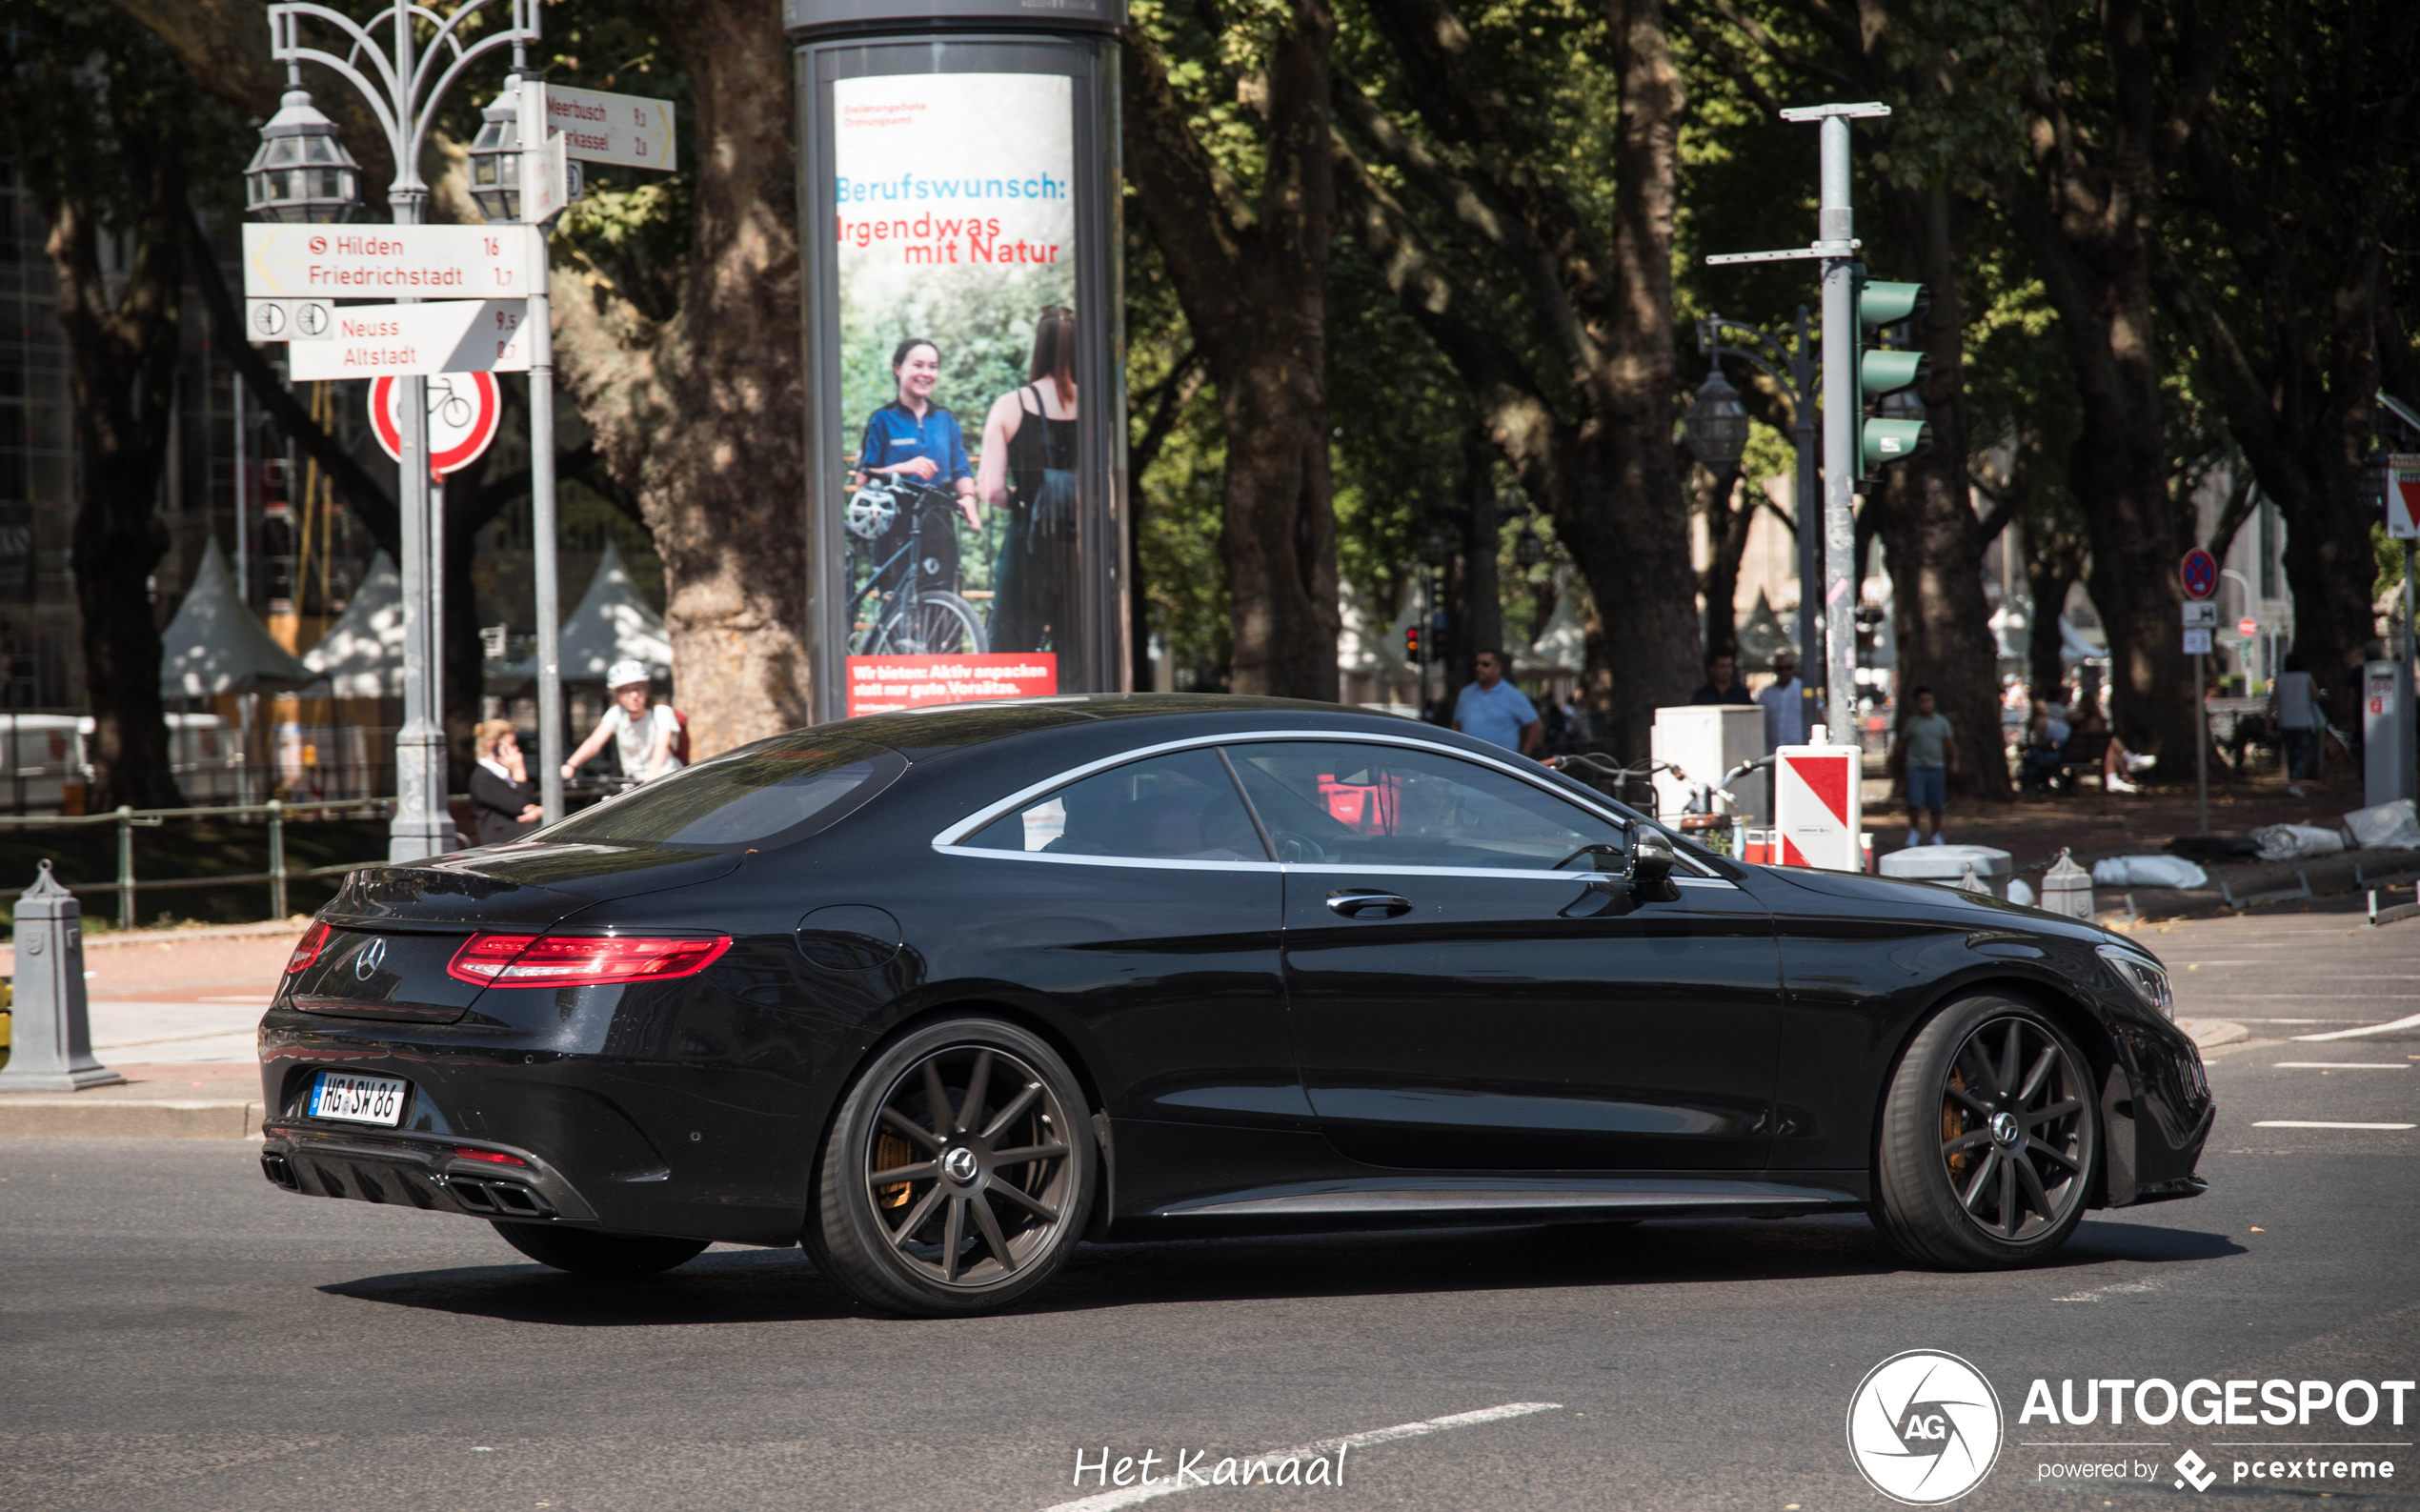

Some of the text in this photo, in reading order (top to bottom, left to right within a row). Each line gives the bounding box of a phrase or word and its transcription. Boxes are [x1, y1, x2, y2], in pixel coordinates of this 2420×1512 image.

[546, 94, 607, 122] Meerbusch
[836, 171, 1065, 203] Berufswunsch:
[837, 211, 1000, 248] Irgendwas
[337, 236, 403, 255] Hilden
[483, 237, 499, 255] 16
[905, 237, 1059, 264] mit Natur
[309, 265, 463, 286] Friedrichstadt
[341, 319, 399, 337] Neuss
[344, 347, 416, 366] Altstadt
[853, 664, 1048, 681] Wir bieten: Aktiv anpacken
[854, 679, 1021, 699] statt nur gute Vorsätze.
[322, 1078, 347, 1113] HG
[373, 1081, 397, 1119] 86
